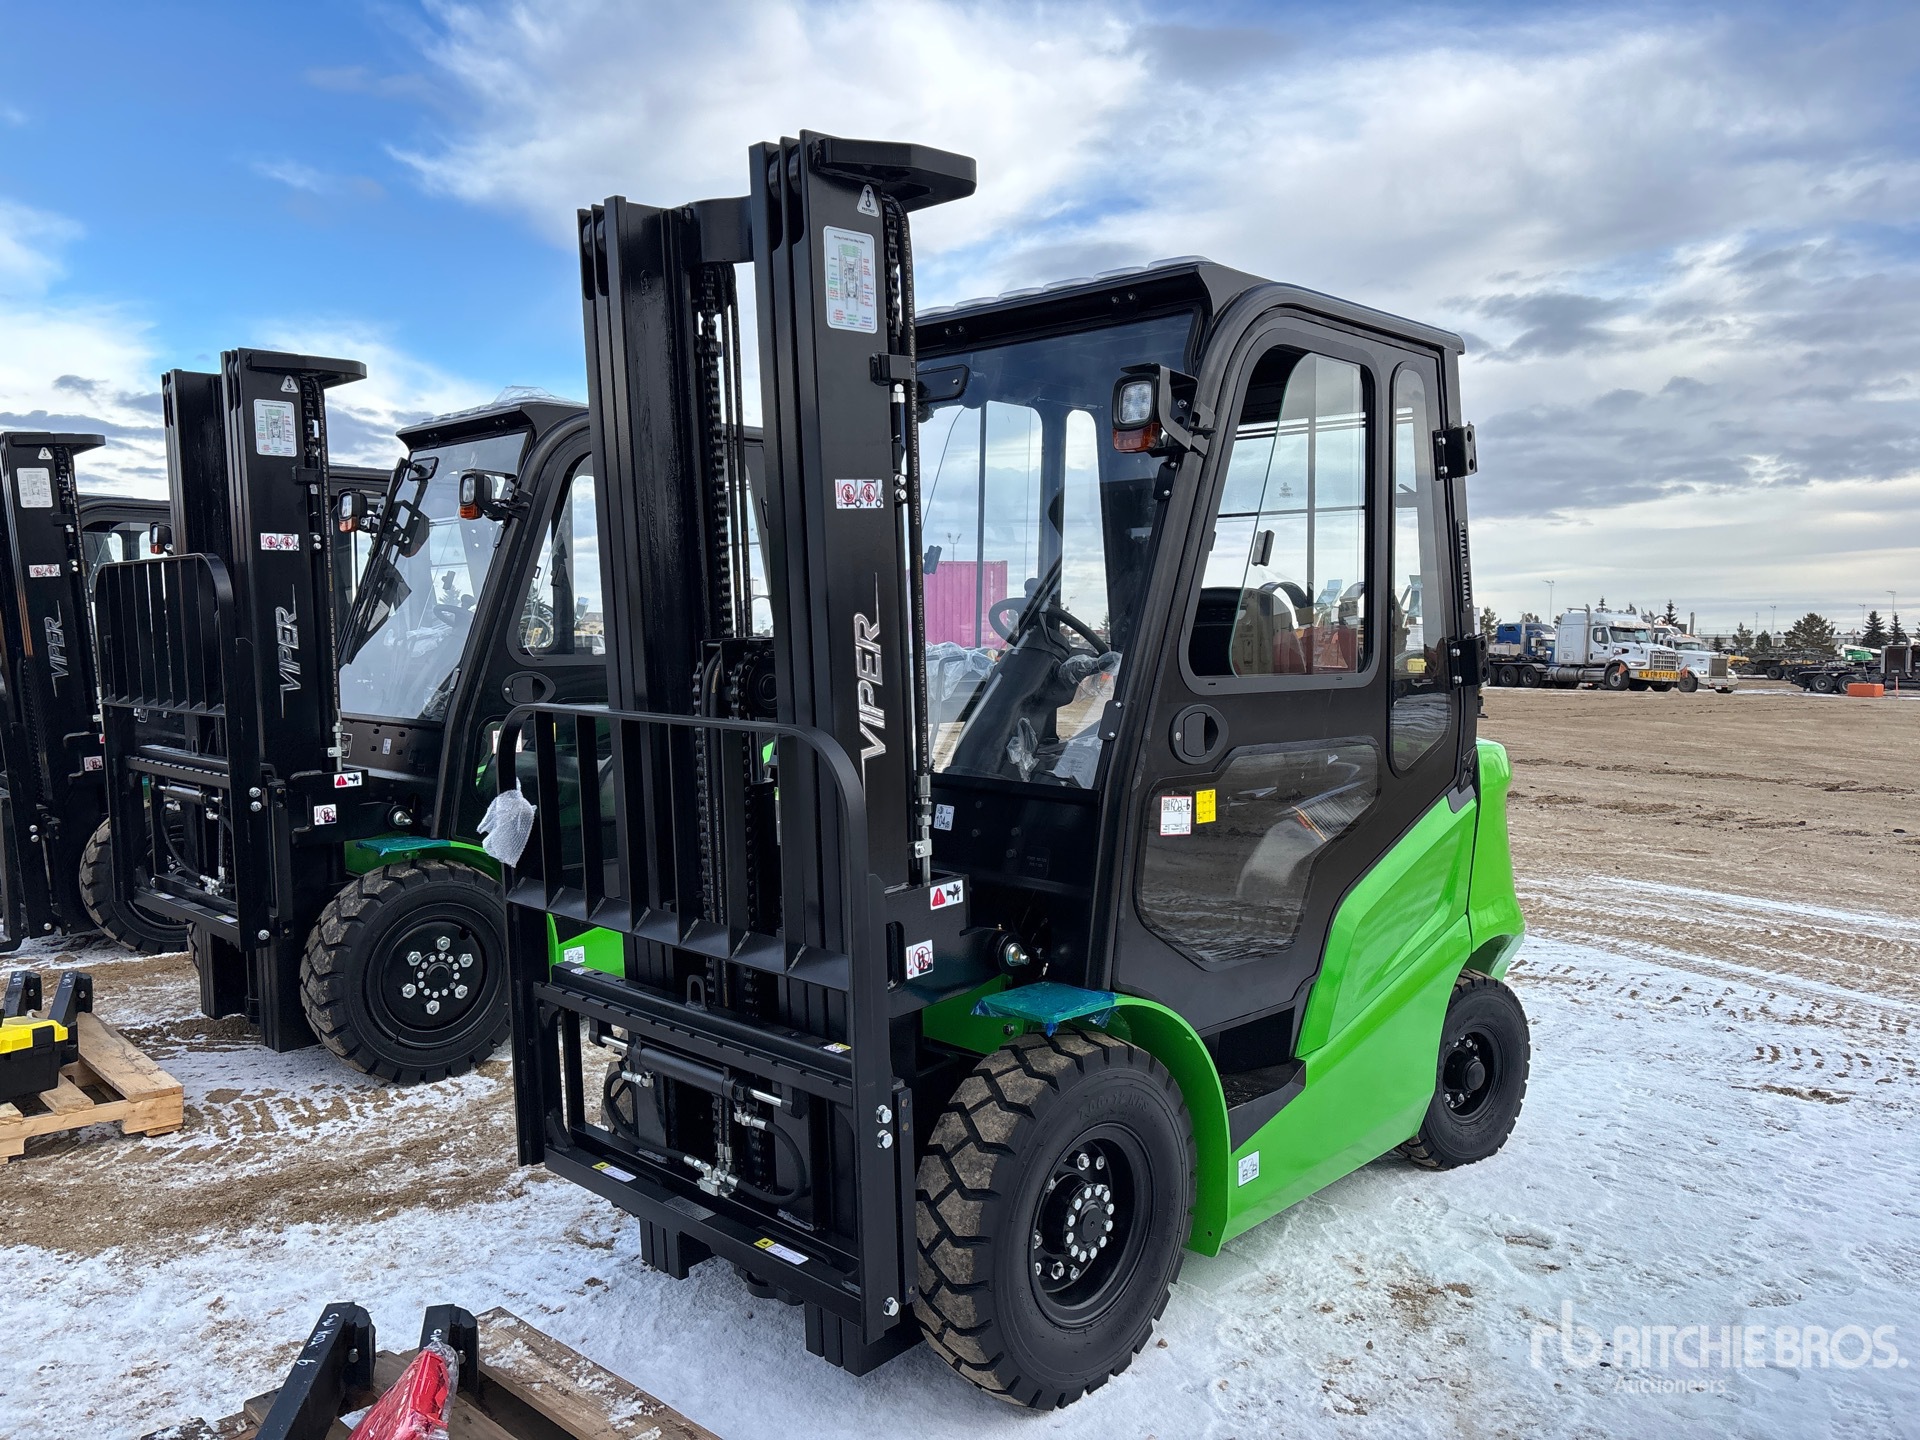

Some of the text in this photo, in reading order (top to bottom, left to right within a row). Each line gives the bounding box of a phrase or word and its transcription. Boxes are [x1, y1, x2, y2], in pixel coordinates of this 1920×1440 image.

[44, 600, 69, 697] VIPER
[275, 584, 301, 718] VIPER
[854, 573, 887, 802] VIPER
